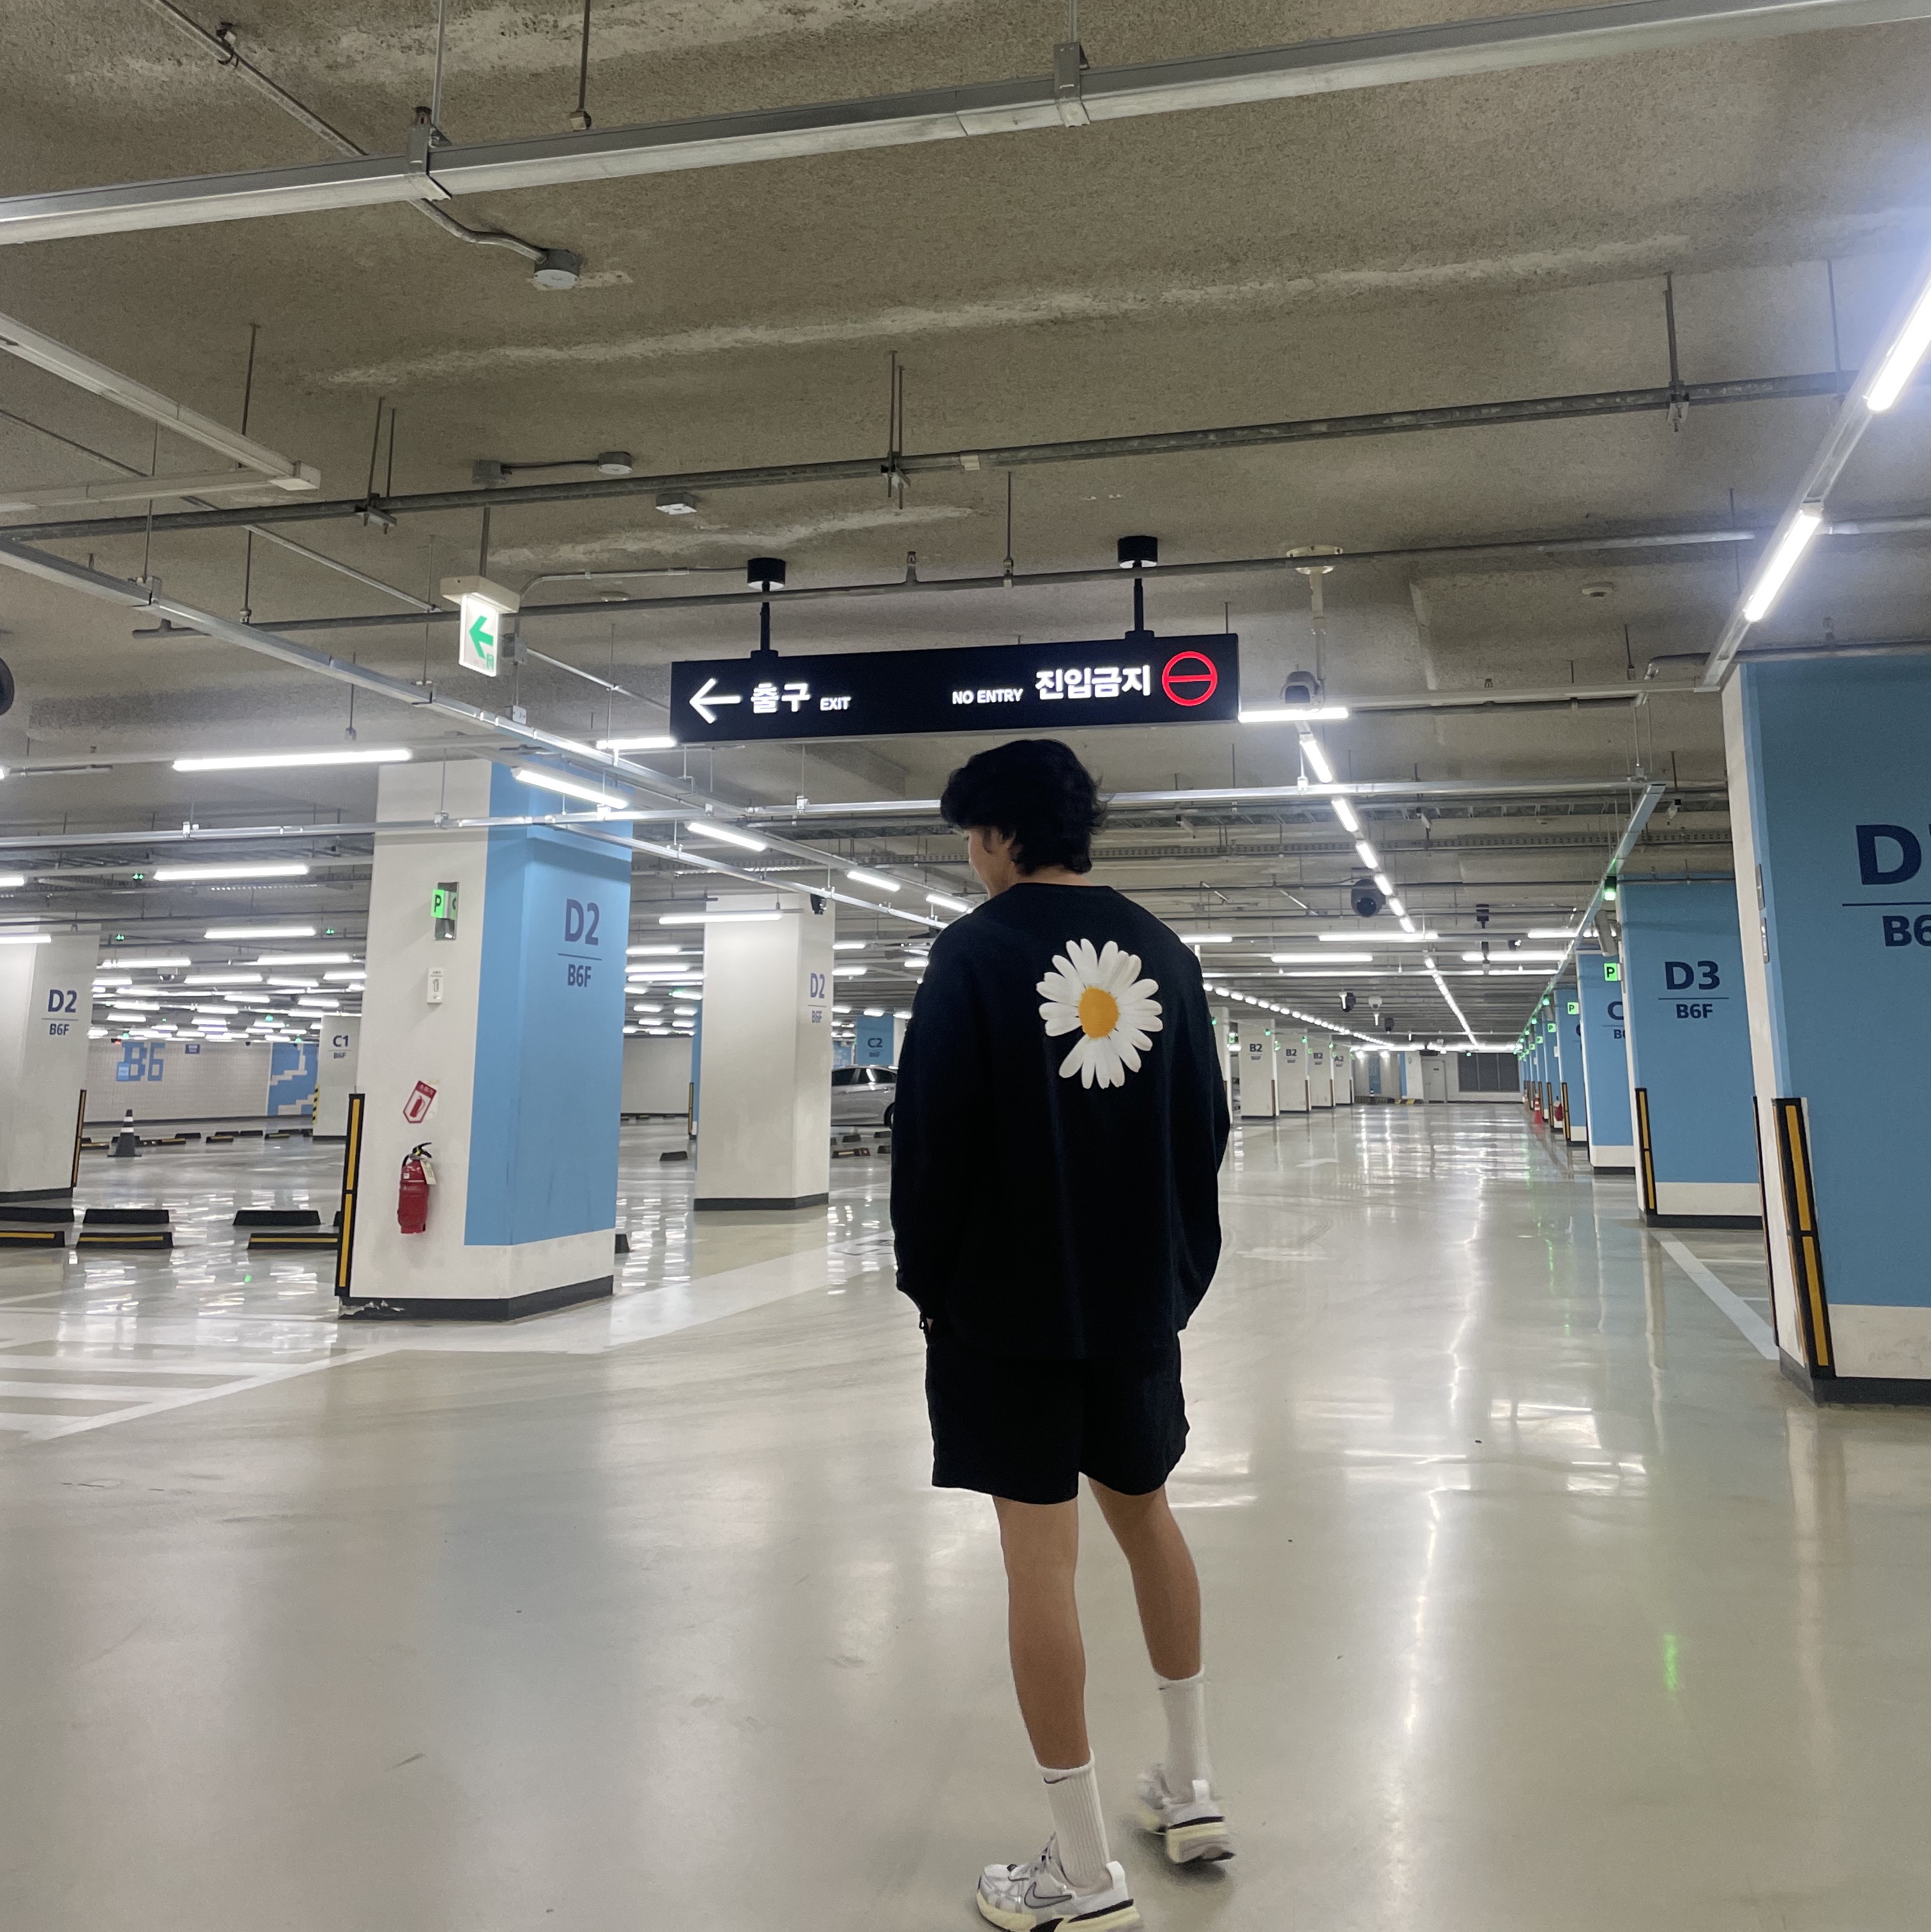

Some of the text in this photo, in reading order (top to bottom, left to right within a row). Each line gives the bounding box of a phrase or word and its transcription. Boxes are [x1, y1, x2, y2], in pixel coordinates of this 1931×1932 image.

[952, 664, 1150, 704] NO ENTRY 진입금지
[750, 682, 851, 714] 출구 EXIT
[1855, 824, 1931, 885] D
[434, 894, 442, 913] P
[565, 898, 600, 946] D2
[1882, 914, 1931, 947] B6
[567, 963, 592, 988] B6F
[1606, 966, 1615, 978] P
[1665, 960, 1720, 990] D3
[810, 972, 825, 999] D2
[48, 988, 77, 1013] D2
[1569, 1004, 1575, 1013] P
[1607, 1001, 1624, 1020] C
[1675, 1003, 1713, 1019] B6F
[49, 1023, 70, 1036] B6F
[333, 1035, 349, 1047] C1
[867, 1038, 883, 1048] C2
[1249, 1043, 1263, 1052] B2
[116, 1042, 165, 1081] B6
